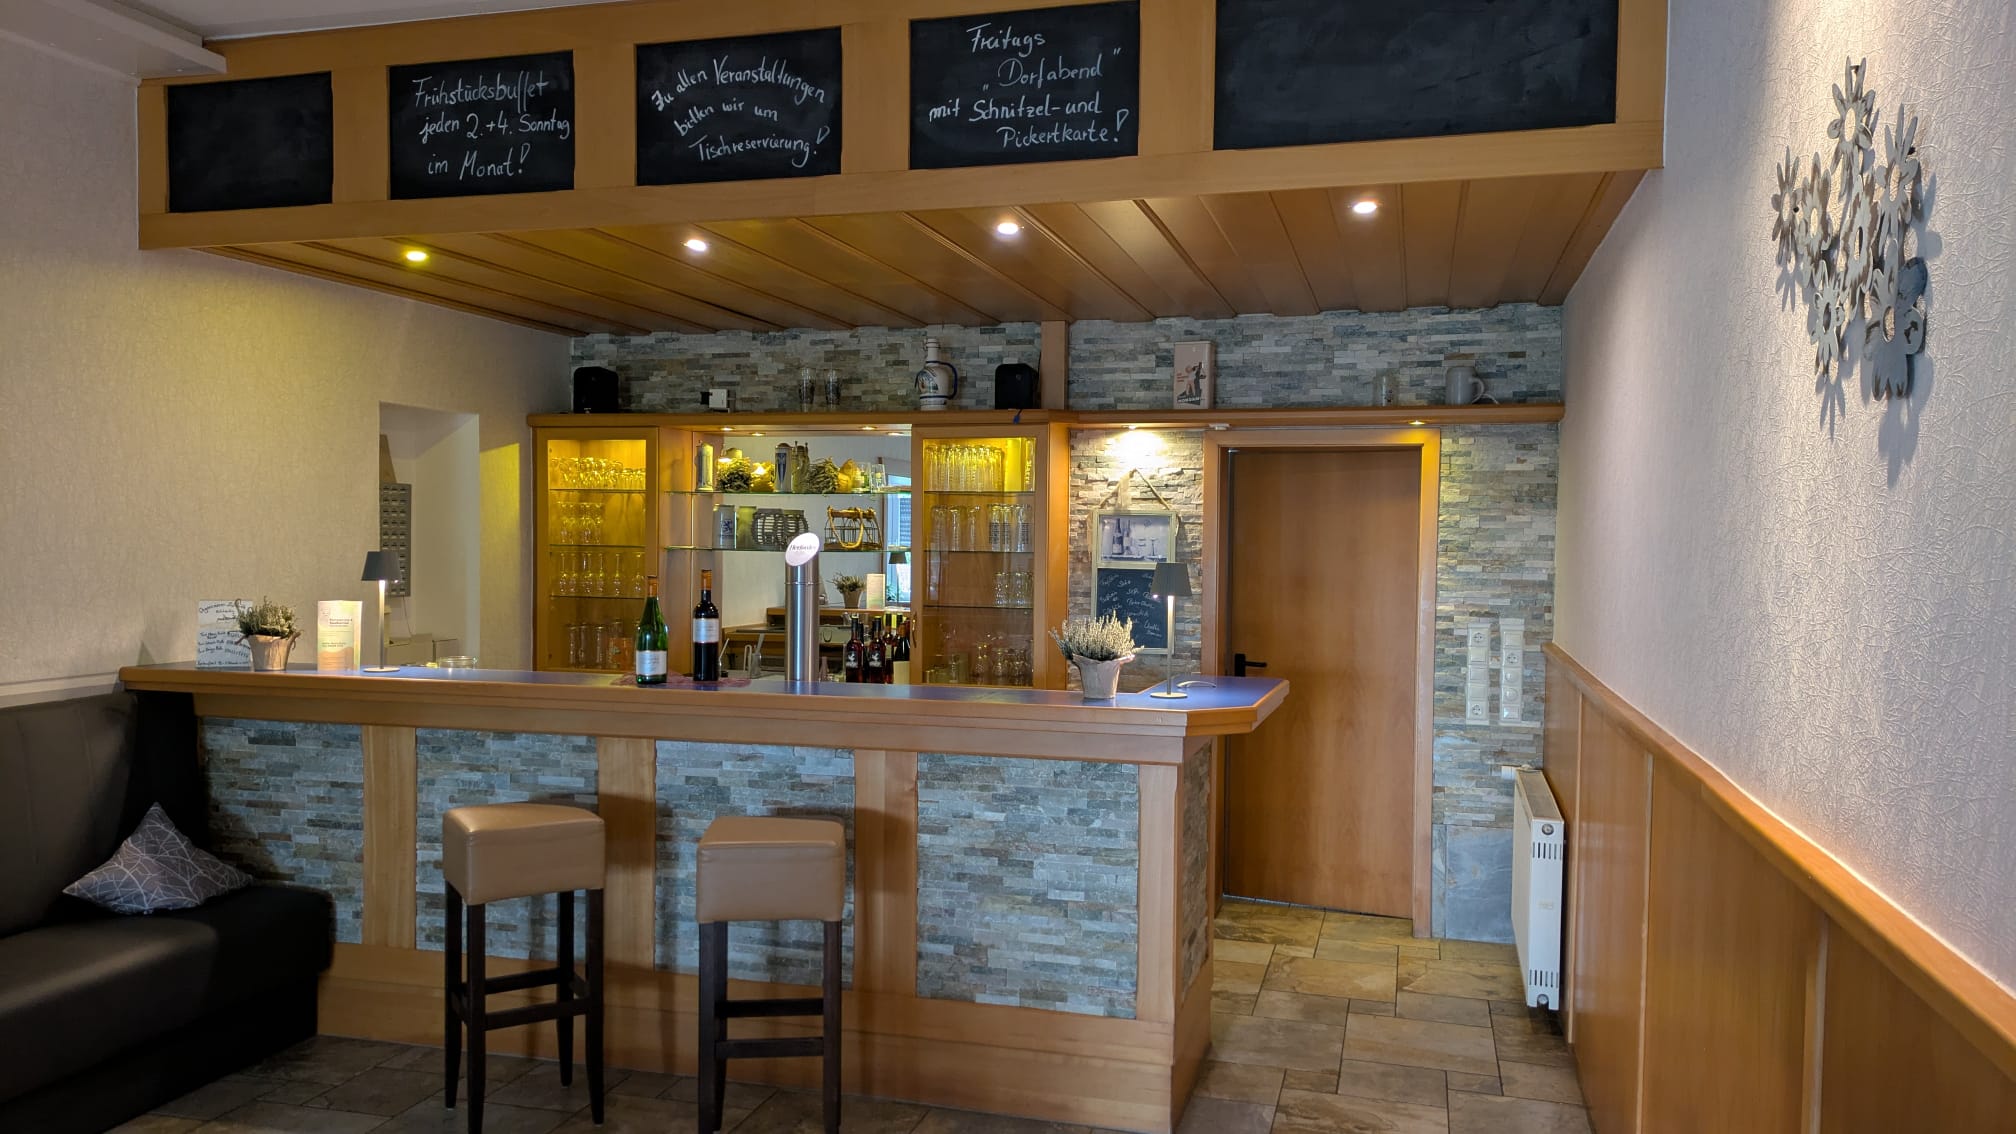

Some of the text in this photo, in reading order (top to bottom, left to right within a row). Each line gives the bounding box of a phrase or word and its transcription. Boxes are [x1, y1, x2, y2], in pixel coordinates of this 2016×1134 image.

[966, 22, 1046, 57] Freitags
[412, 70, 549, 113] Frühstücksbuffet
[651, 54, 825, 112] Zu allen Veranstaltungen
[419, 112, 460, 144] jeden
[518, 108, 571, 140] Sonntag
[673, 97, 779, 137] bitten wir um
[929, 97, 960, 122] mit
[1065, 90, 1102, 114] und
[688, 125, 830, 168] Tischreservierung!
[996, 108, 1129, 148] Pickertkarte!
[428, 142, 531, 181] im Monat!
